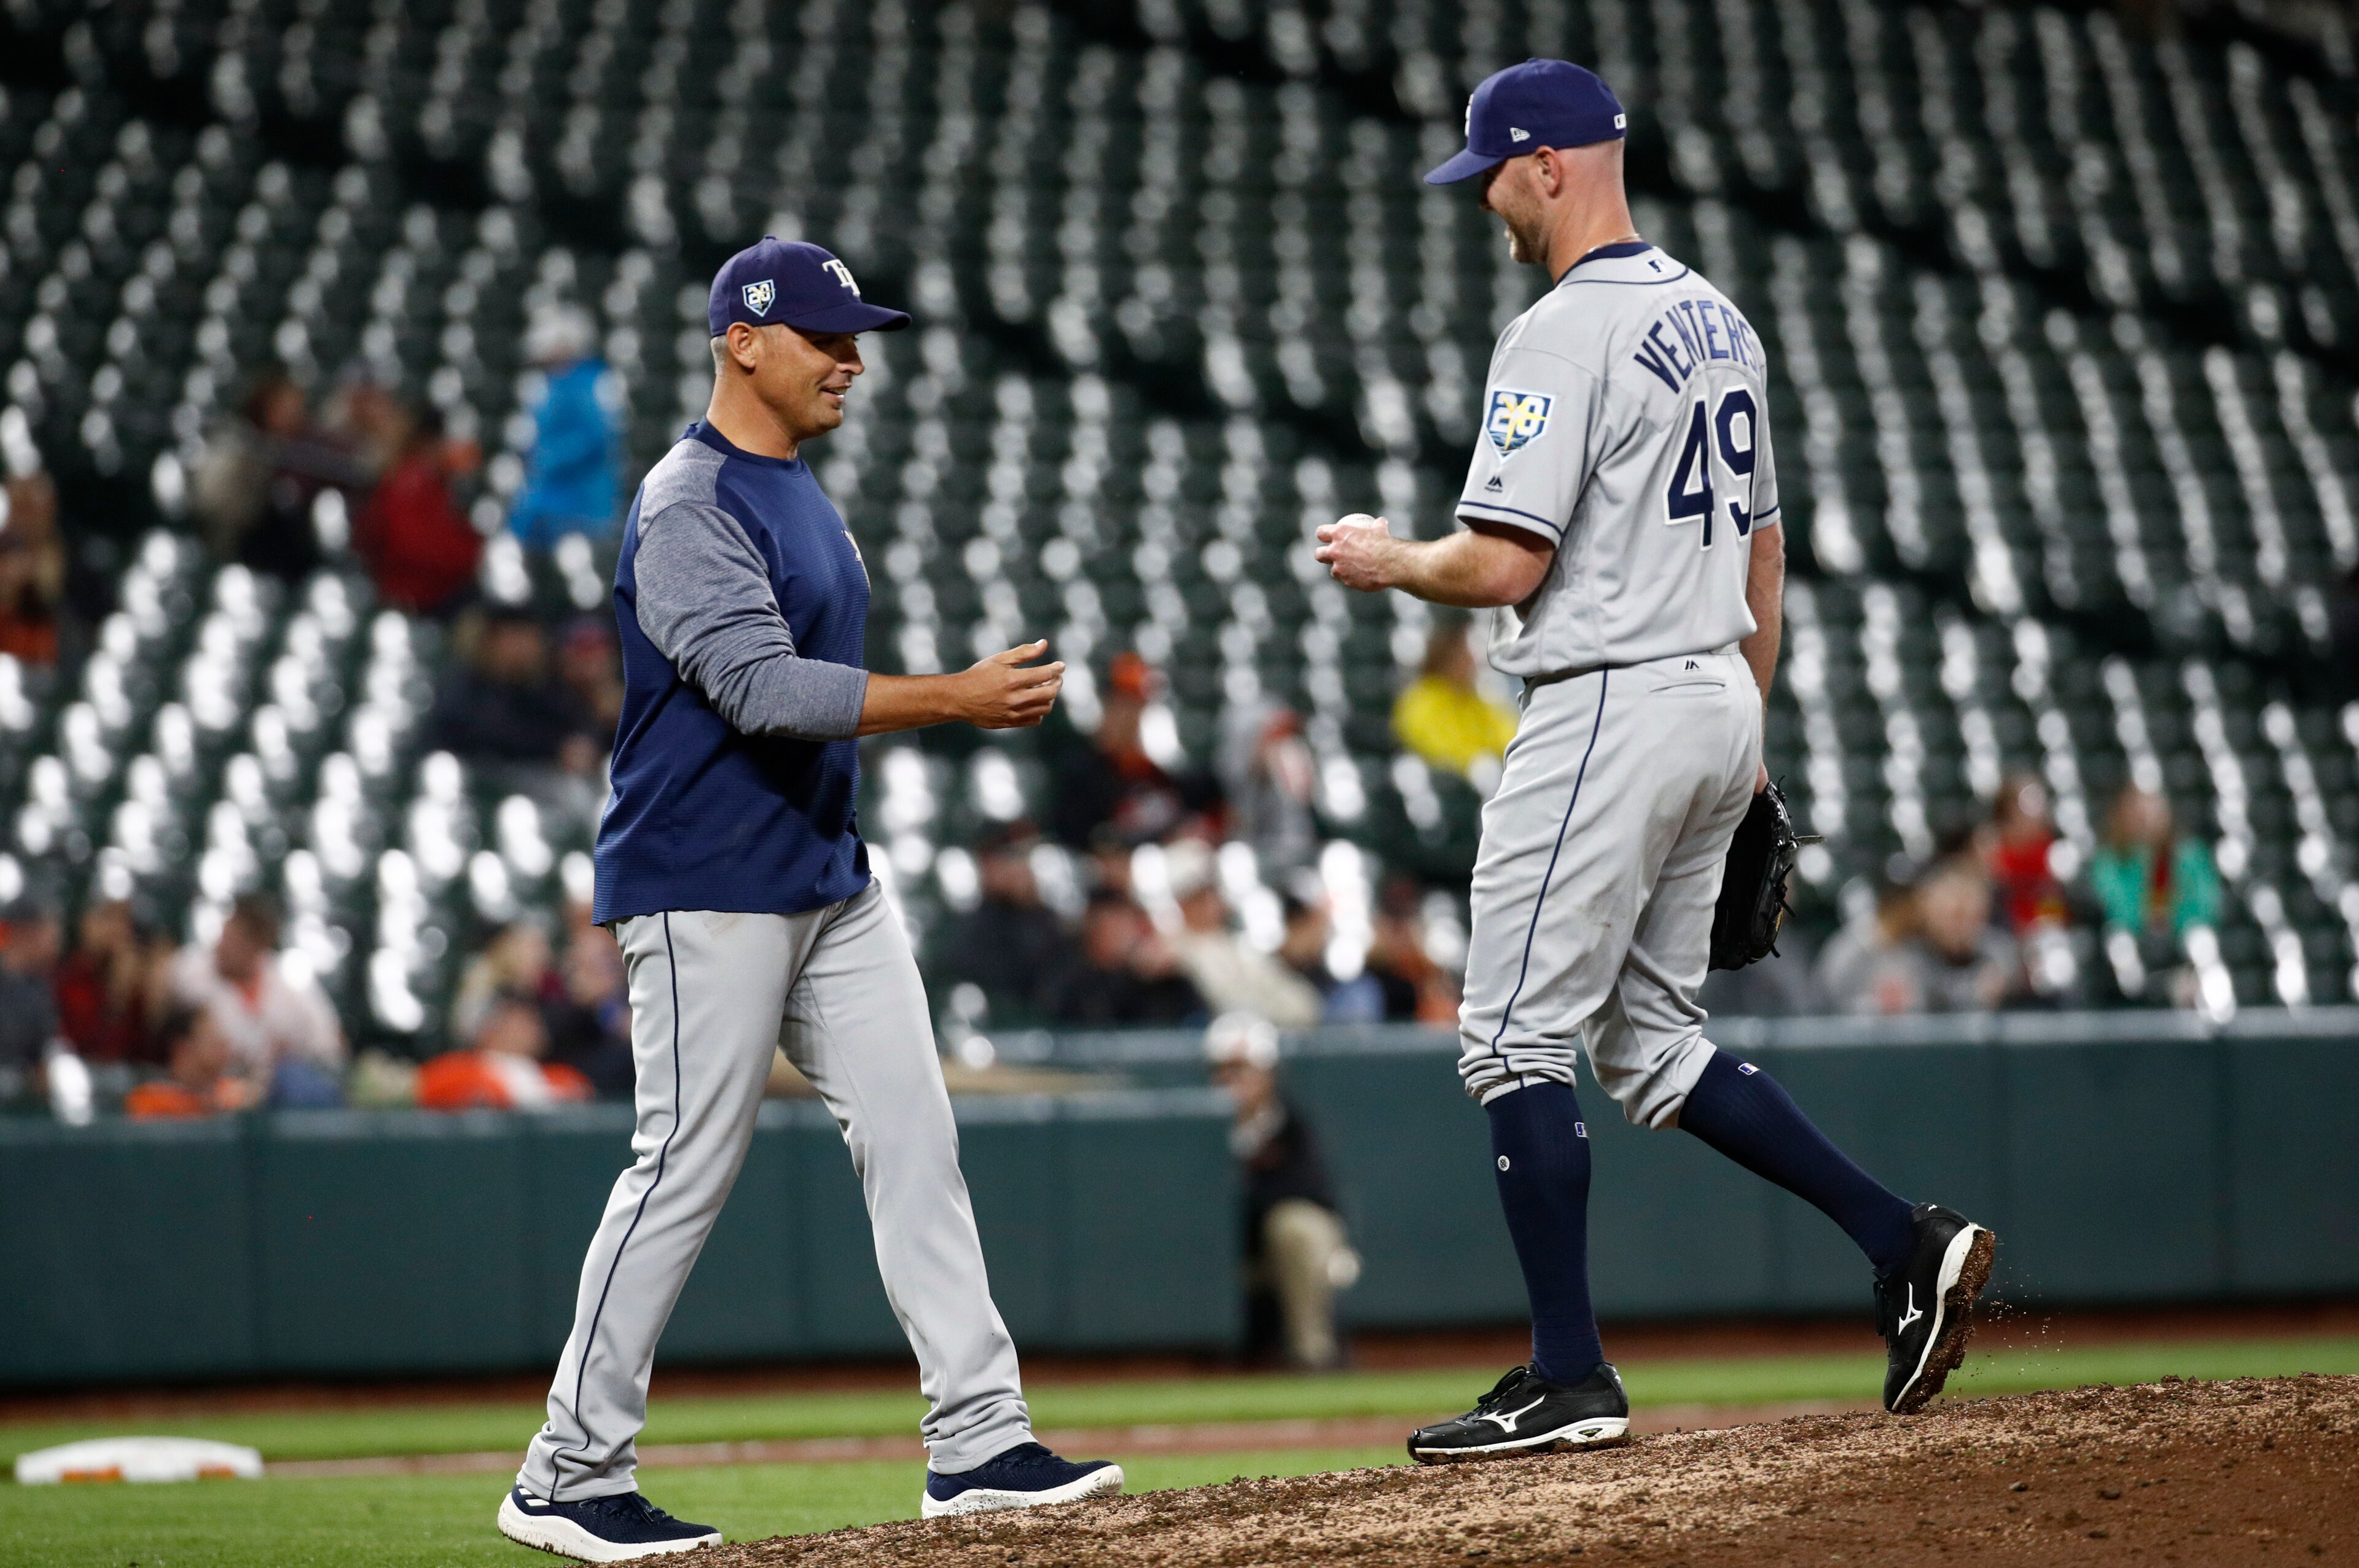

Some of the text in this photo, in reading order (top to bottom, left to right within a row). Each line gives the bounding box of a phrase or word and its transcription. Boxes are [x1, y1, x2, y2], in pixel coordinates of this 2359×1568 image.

[747, 283, 770, 305] 20
[1633, 300, 1758, 394] VENTERS
[1489, 392, 1545, 435] 20
[1664, 383, 1758, 551] 49
